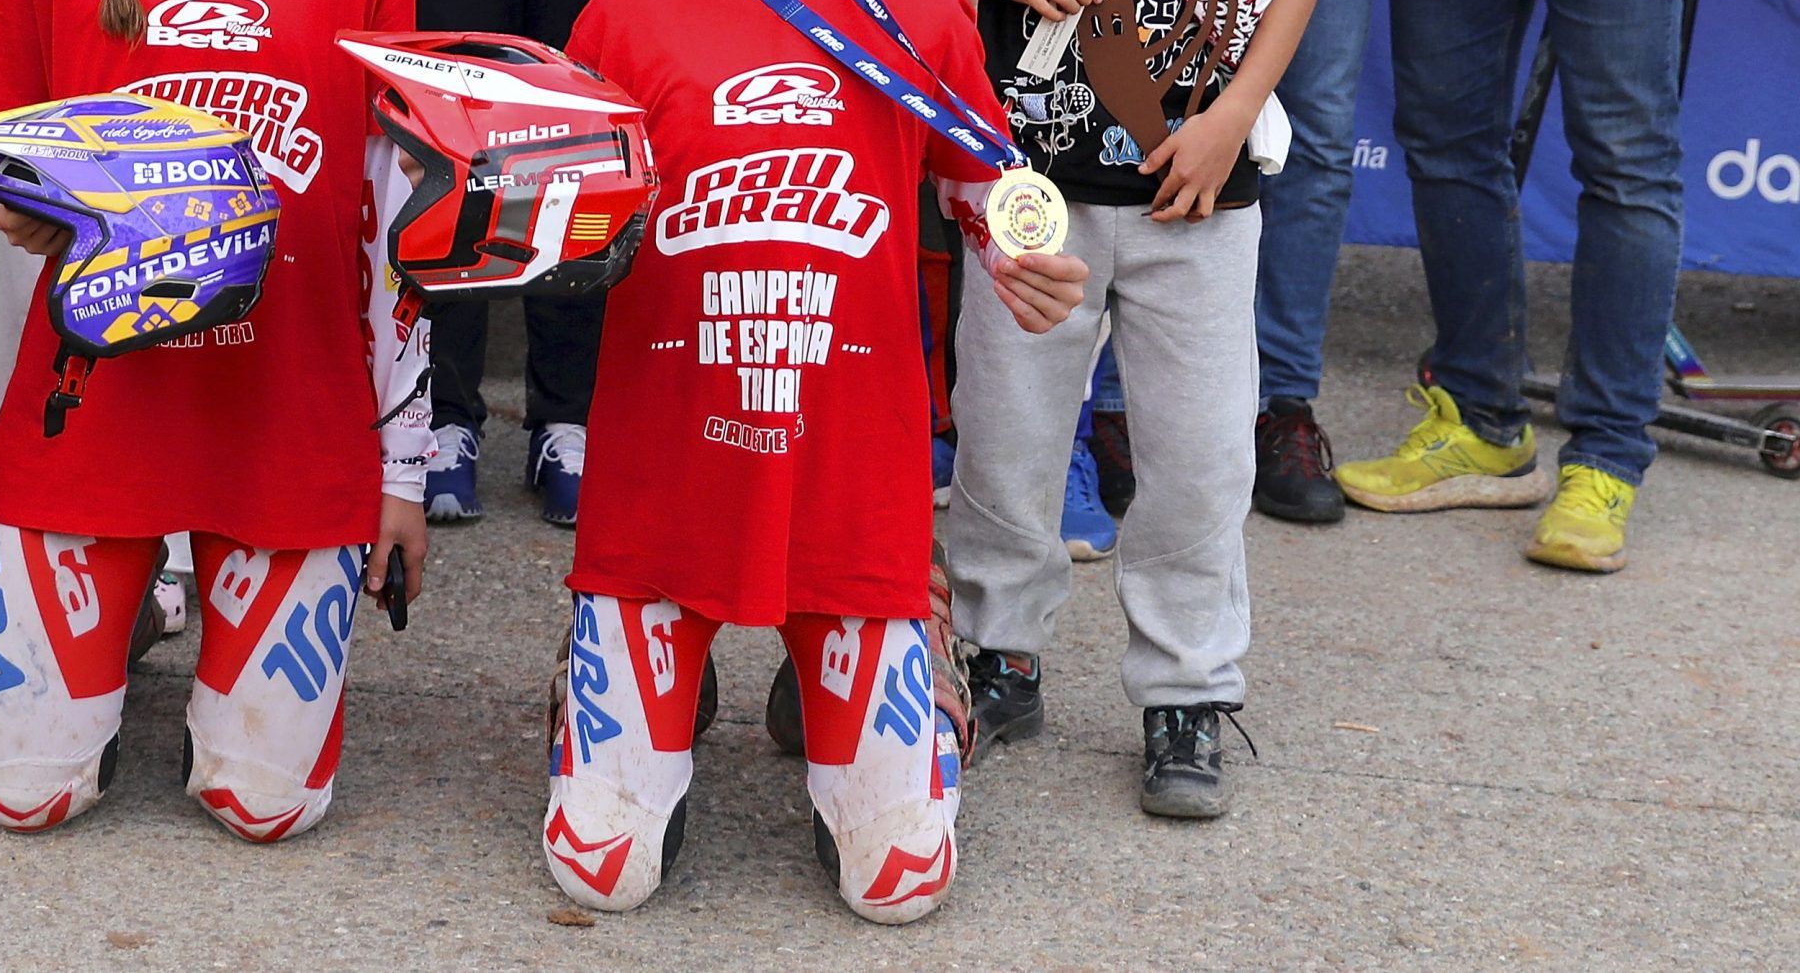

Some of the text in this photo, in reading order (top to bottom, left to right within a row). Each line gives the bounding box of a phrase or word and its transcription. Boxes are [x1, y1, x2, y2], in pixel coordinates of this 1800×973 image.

[146, 28, 260, 52] Beta
[809, 25, 845, 53] rfme
[384, 53, 485, 80] GIRALET 13
[854, 58, 891, 86] rfme
[712, 104, 833, 126] Beta
[901, 92, 937, 120] rfme
[101, 125, 192, 142] ride together
[486, 122, 571, 147] hebo
[947, 125, 985, 153] rfme
[167, 157, 241, 185] BOIX
[692, 151, 844, 204] PAU
[663, 186, 888, 242] GIRALT
[72, 293, 133, 322] TRIAL TEAM
[698, 320, 733, 365] DE
